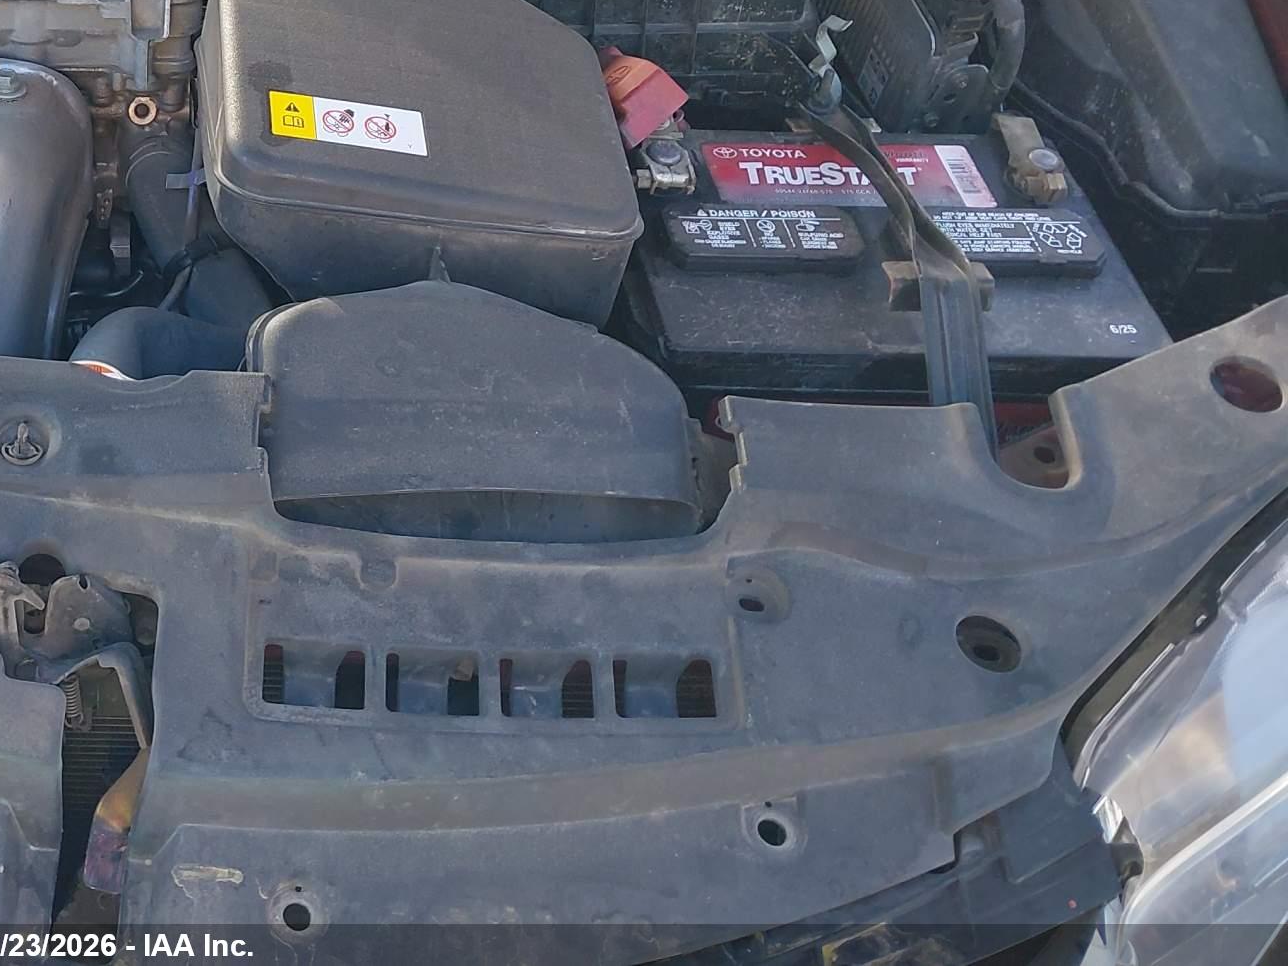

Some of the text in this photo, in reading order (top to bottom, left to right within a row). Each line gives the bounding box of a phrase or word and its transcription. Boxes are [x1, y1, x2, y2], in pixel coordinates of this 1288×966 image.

[738, 148, 807, 158] TOYOTA
[708, 209, 816, 218] DANGER / POISON
[1109, 325, 1137, 334] 6/25
